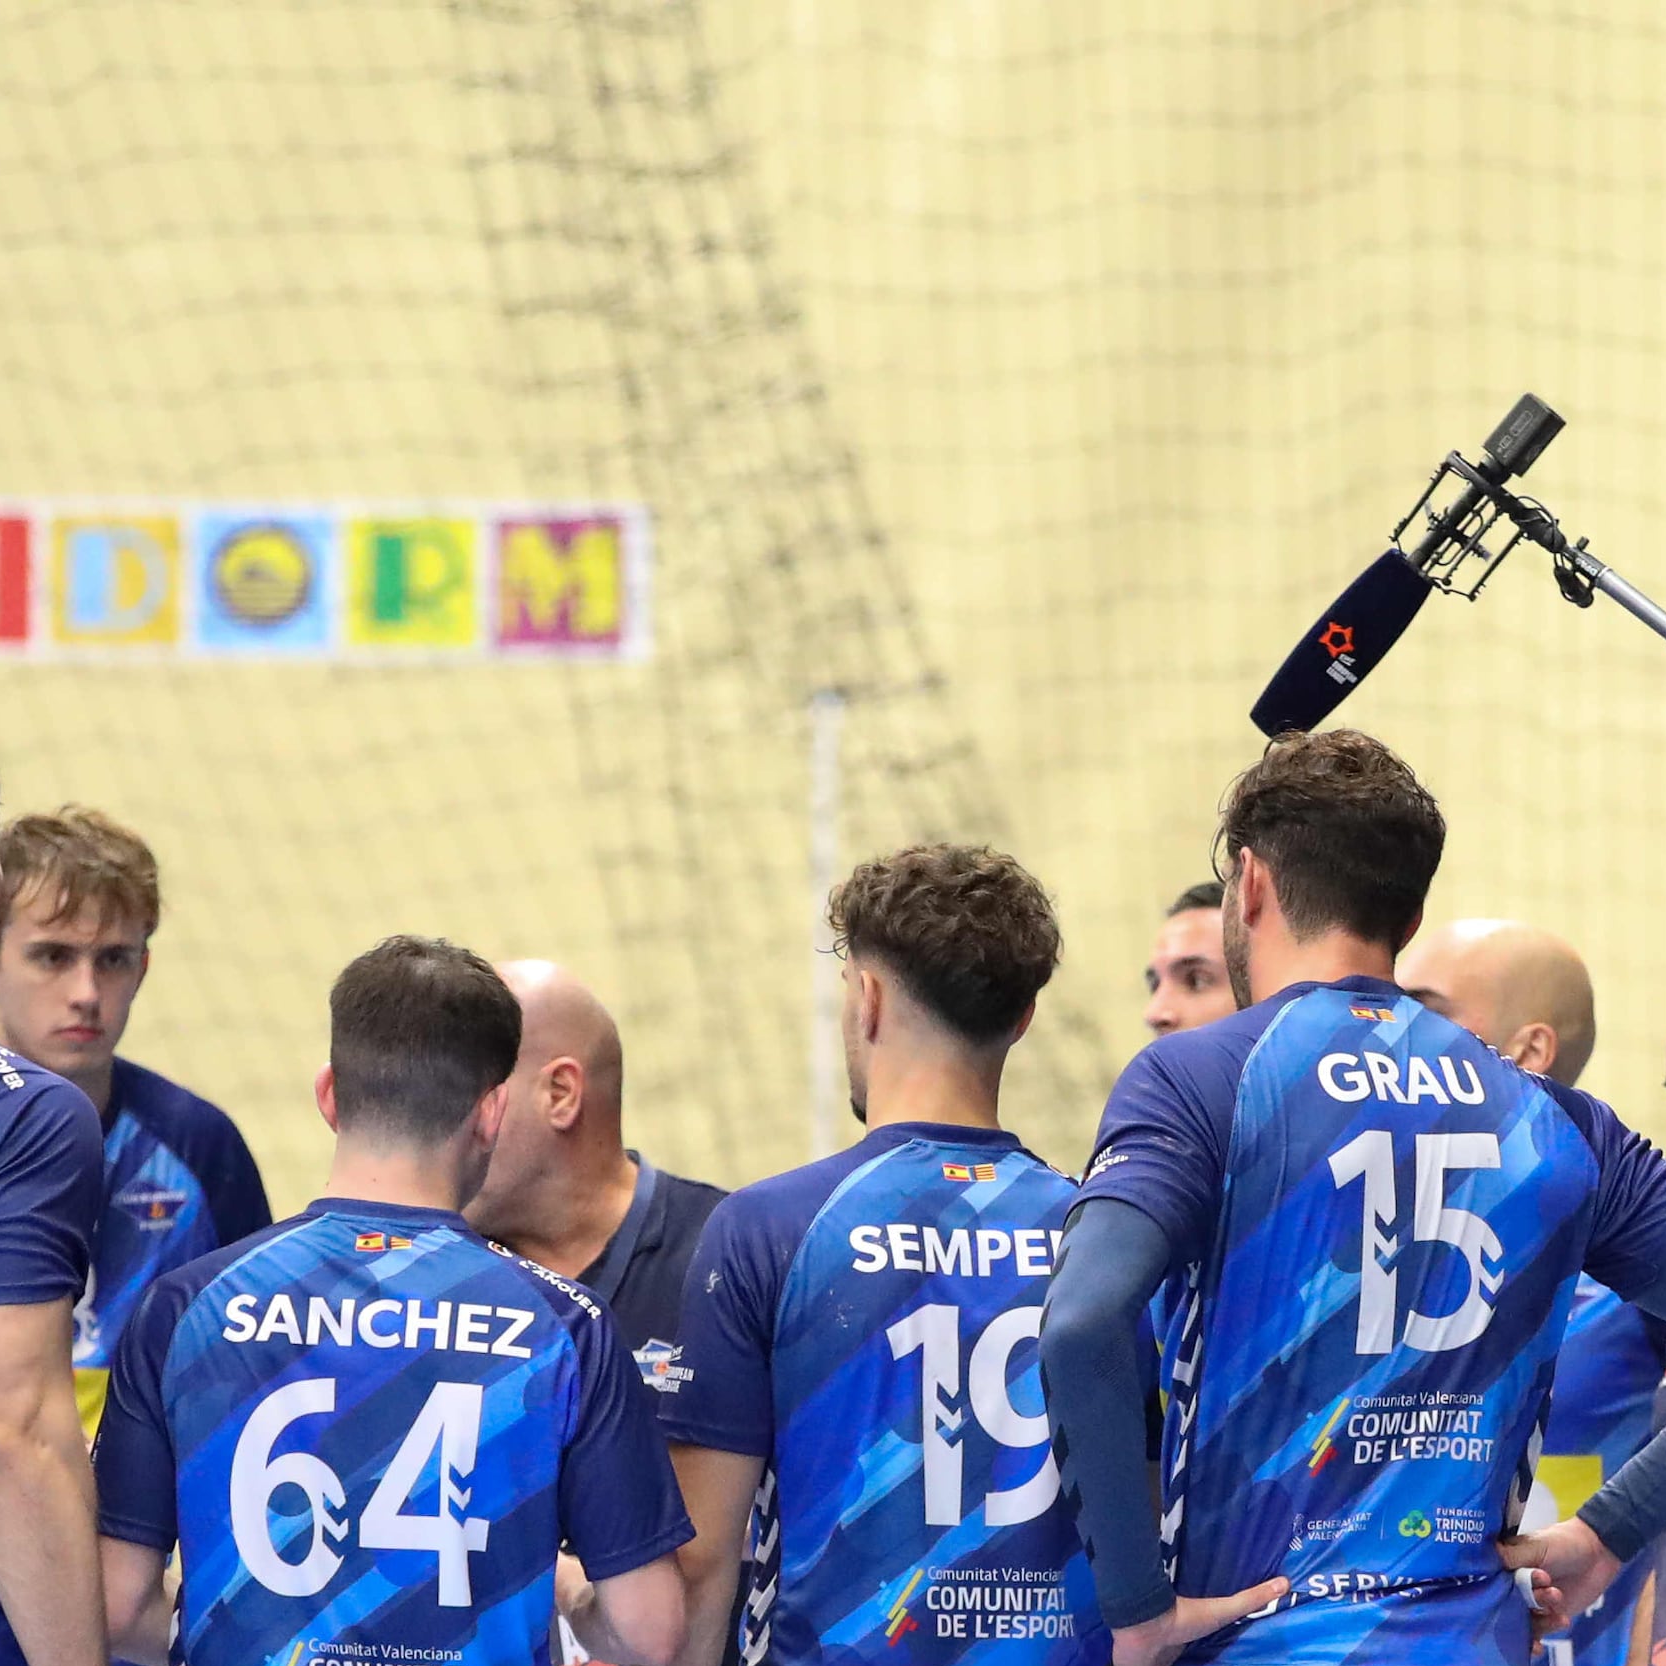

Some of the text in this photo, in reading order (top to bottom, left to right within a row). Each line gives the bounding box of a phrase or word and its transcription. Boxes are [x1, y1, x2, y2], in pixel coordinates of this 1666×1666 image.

[1317, 1051, 1485, 1105] GRAU
[1328, 1129, 1505, 1355] 15
[224, 1294, 535, 1359] SANCHEZ
[1353, 1390, 1484, 1409] Comunitat Valenciana
[886, 1303, 1062, 1527] 19
[1348, 1410, 1482, 1437] COMUNITAT
[1354, 1437, 1494, 1464] DE L'ESPORT
[229, 1377, 489, 1608] 64
[1435, 1517, 1484, 1532] TRINIDAD
[1436, 1507, 1485, 1518] FUNDACI
[1435, 1532, 1482, 1543] ALFONSO
[928, 1566, 1064, 1583] Comunitat Valencia
[926, 1586, 1066, 1611] COMUNITAT
[937, 1614, 1075, 1639] DE L'ESPORT
[308, 1638, 463, 1661] Comunitat Valenciana
